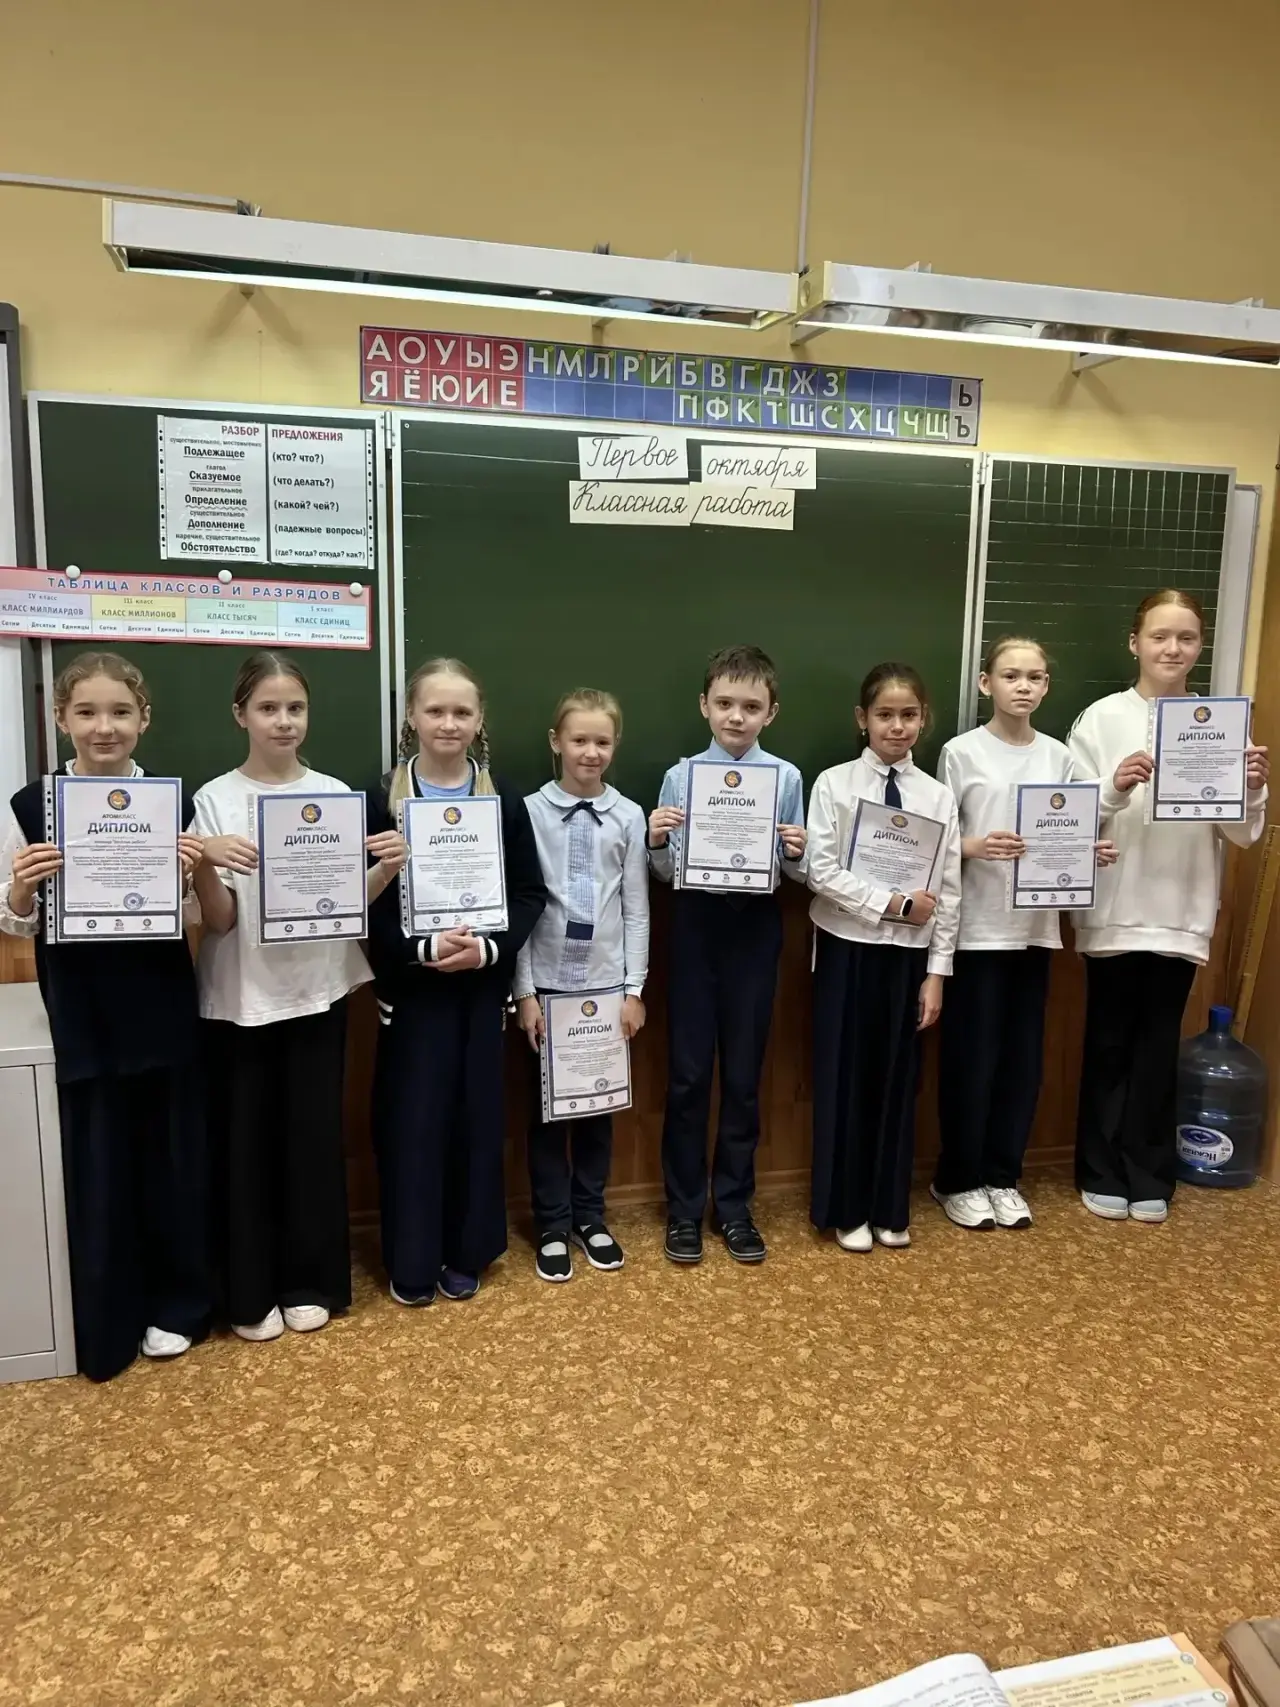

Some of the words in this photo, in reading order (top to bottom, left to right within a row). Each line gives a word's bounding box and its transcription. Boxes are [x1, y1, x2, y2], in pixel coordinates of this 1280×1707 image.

[222, 426, 259, 436] РАЗБОР
[272, 429, 343, 441] ПРЕДЛОЖЕНИЯ
[184, 446, 245, 458] Подлежащее
[272, 452, 296, 462] (кто?
[300, 454, 324, 464] что?)
[587, 436, 678, 478] Первое
[707, 448, 808, 488] октября
[190, 470, 241, 482] Сказуемое
[273, 476, 292, 486] (что
[294, 478, 334, 488] делать?)
[192, 486, 242, 494] прилагательное
[185, 494, 247, 506] Определение
[274, 500, 311, 510] (какой?
[314, 502, 339, 512] чей?)
[573, 481, 688, 513] Классная
[691, 486, 792, 523] работа
[188, 519, 245, 529] Дополнение
[274, 524, 322, 534] (падежные
[326, 527, 366, 536] вопросы)
[206, 534, 260, 542] существительное
[181, 542, 256, 553] Обстоятельство
[48, 578, 129, 592] ТАБЛИЦА
[141, 582, 220, 595] КЛАССОВ
[232, 587, 241, 595] И
[253, 587, 340, 600] РАЗРЯДОВ
[2, 604, 28, 612] КЛАСС
[30, 606, 84, 615] МИЛЛИАРДОВ
[128, 610, 176, 618] МИЛЛИОНОВ
[1178, 732, 1225, 742] ДИПЛОМ
[708, 797, 755, 806] ДИПЛОМ
[88, 822, 151, 834] ДИПЛОМ
[1036, 819, 1078, 828] ДИПЛОМ
[284, 834, 340, 846] ДИПЛОМ
[429, 834, 478, 845] ДИПЛОМ
[873, 830, 918, 846] ДИПЛОМ
[568, 1024, 612, 1037] ДИПЛОМ
